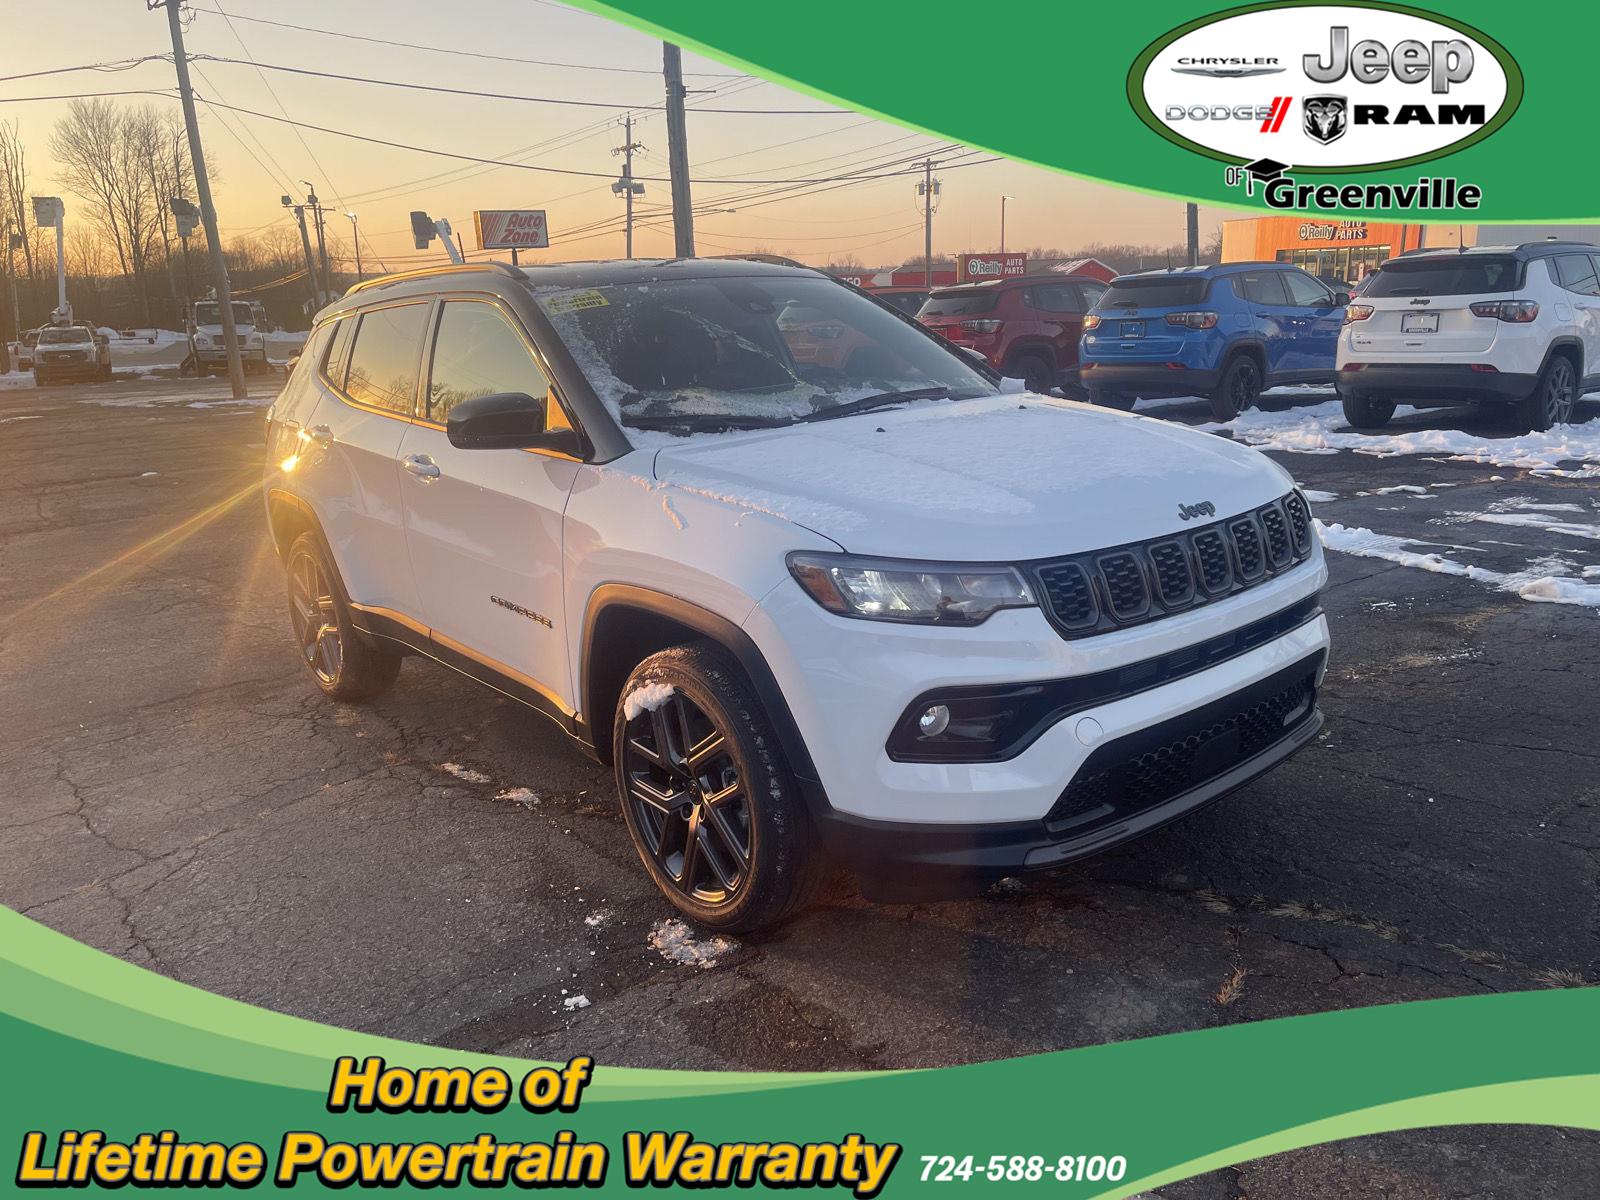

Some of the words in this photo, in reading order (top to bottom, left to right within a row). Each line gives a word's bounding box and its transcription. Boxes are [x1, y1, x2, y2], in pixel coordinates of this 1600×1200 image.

[507, 213, 543, 227] Auto
[501, 228, 539, 243] Zone
[1298, 223, 1334, 240] O'Reilly
[1336, 229, 1364, 240] PARTS
[968, 259, 1003, 275] O'Reilly
[1006, 258, 1023, 266] AUTO
[1004, 266, 1024, 274] PARTS
[1178, 500, 1216, 521] Jeep
